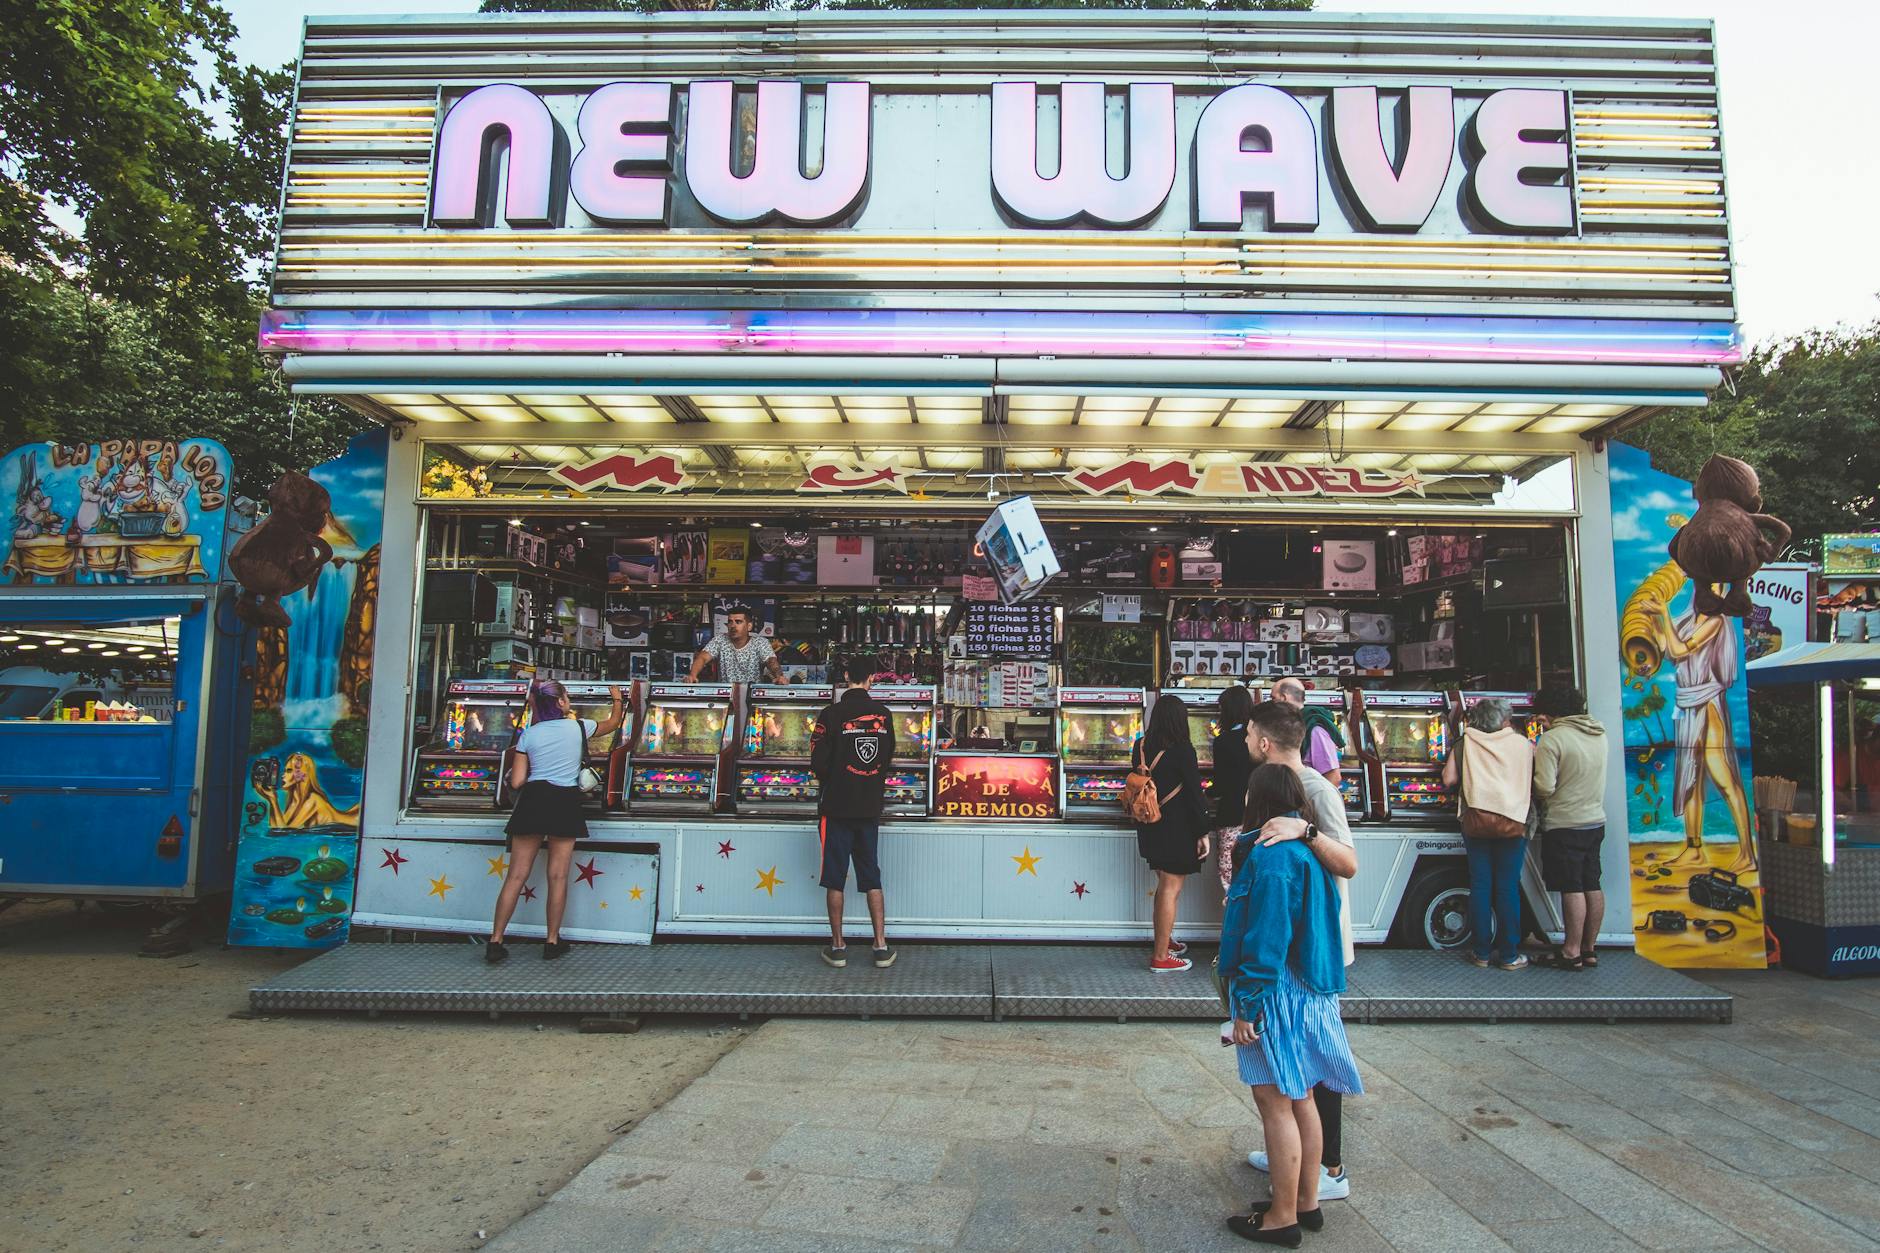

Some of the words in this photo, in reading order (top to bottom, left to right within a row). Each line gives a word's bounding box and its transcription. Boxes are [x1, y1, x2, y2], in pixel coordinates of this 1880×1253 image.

[433, 81, 872, 228] NEW
[990, 82, 1575, 234] WAVE
[52, 443, 90, 468] LA
[100, 439, 179, 470] PAPA
[181, 445, 225, 511] LOCA
[1074, 460, 1412, 493] MENDEZ
[1748, 575, 1804, 605] RACING
[969, 624, 985, 632] 30
[989, 624, 1028, 633] fichas
[986, 634, 1023, 642] fichas
[1028, 634, 1042, 642] 10
[991, 644, 1025, 652] fichas
[982, 783, 1010, 796] DE
[946, 802, 1048, 817] PREMIOS
